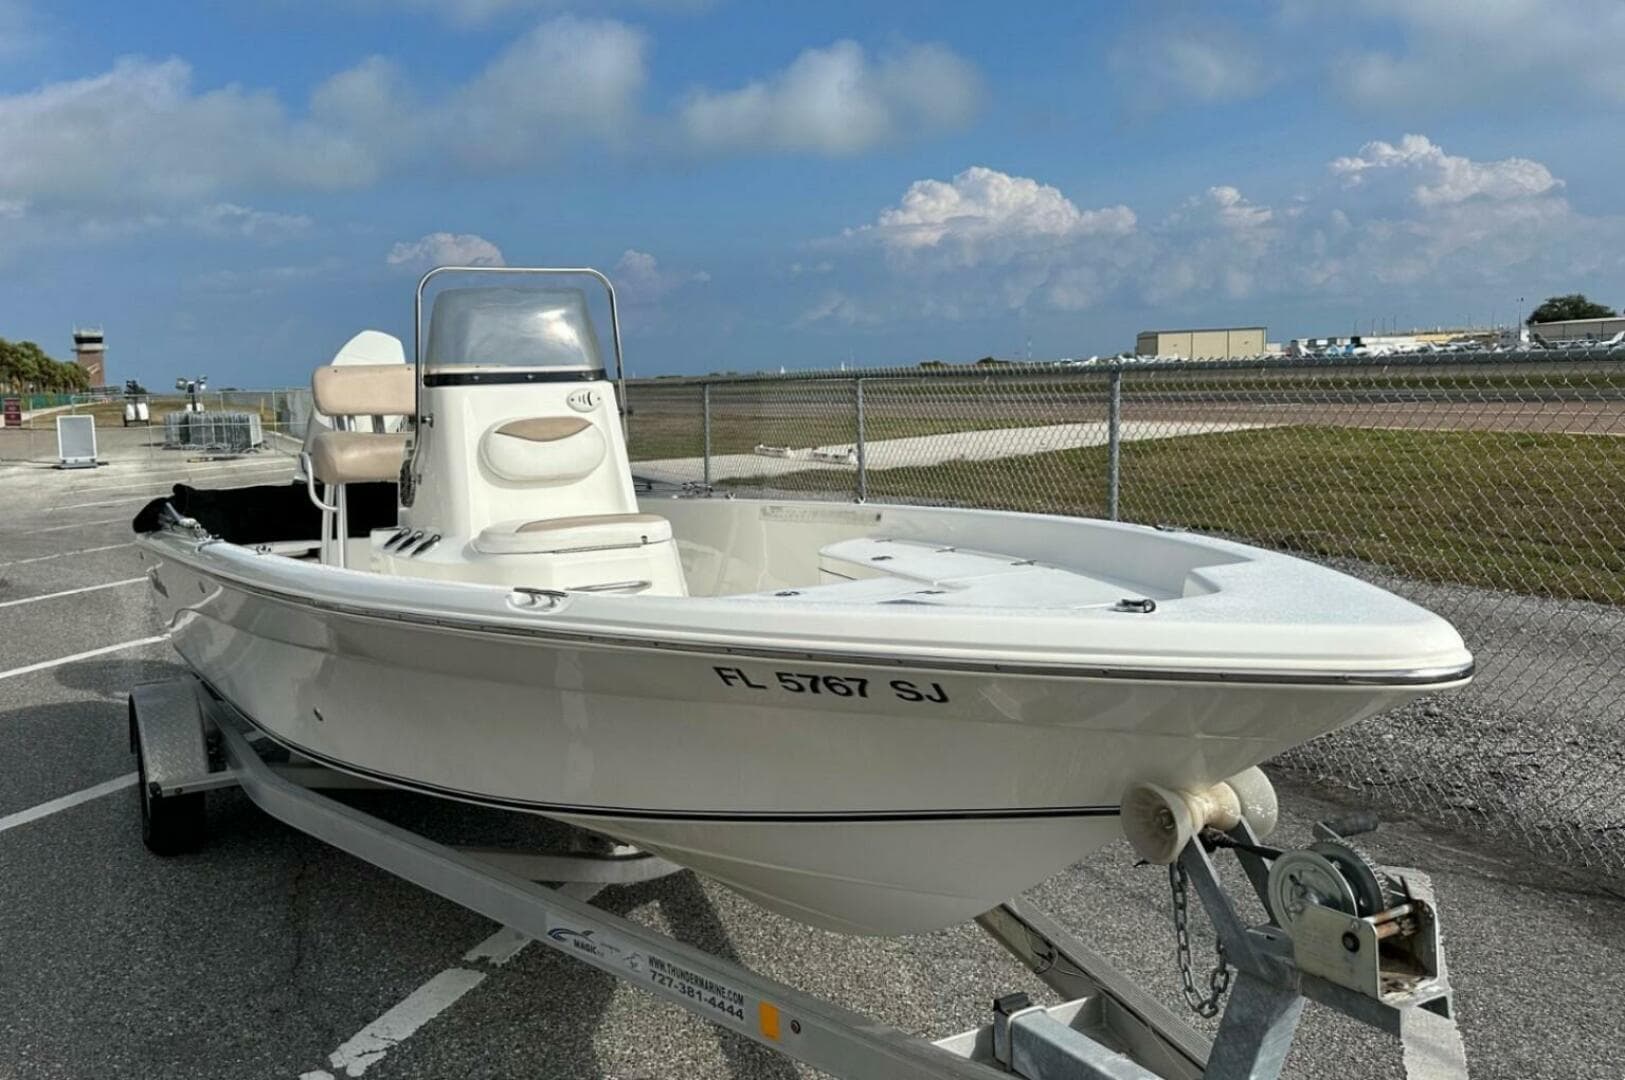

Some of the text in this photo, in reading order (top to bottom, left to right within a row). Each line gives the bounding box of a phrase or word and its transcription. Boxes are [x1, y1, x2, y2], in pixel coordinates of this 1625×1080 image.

[713, 666, 950, 704] FL 5767 SJ
[648, 955, 745, 1007] WWW.THUNDERMARINE.COM
[649, 969, 745, 1021] 727-381-4444
